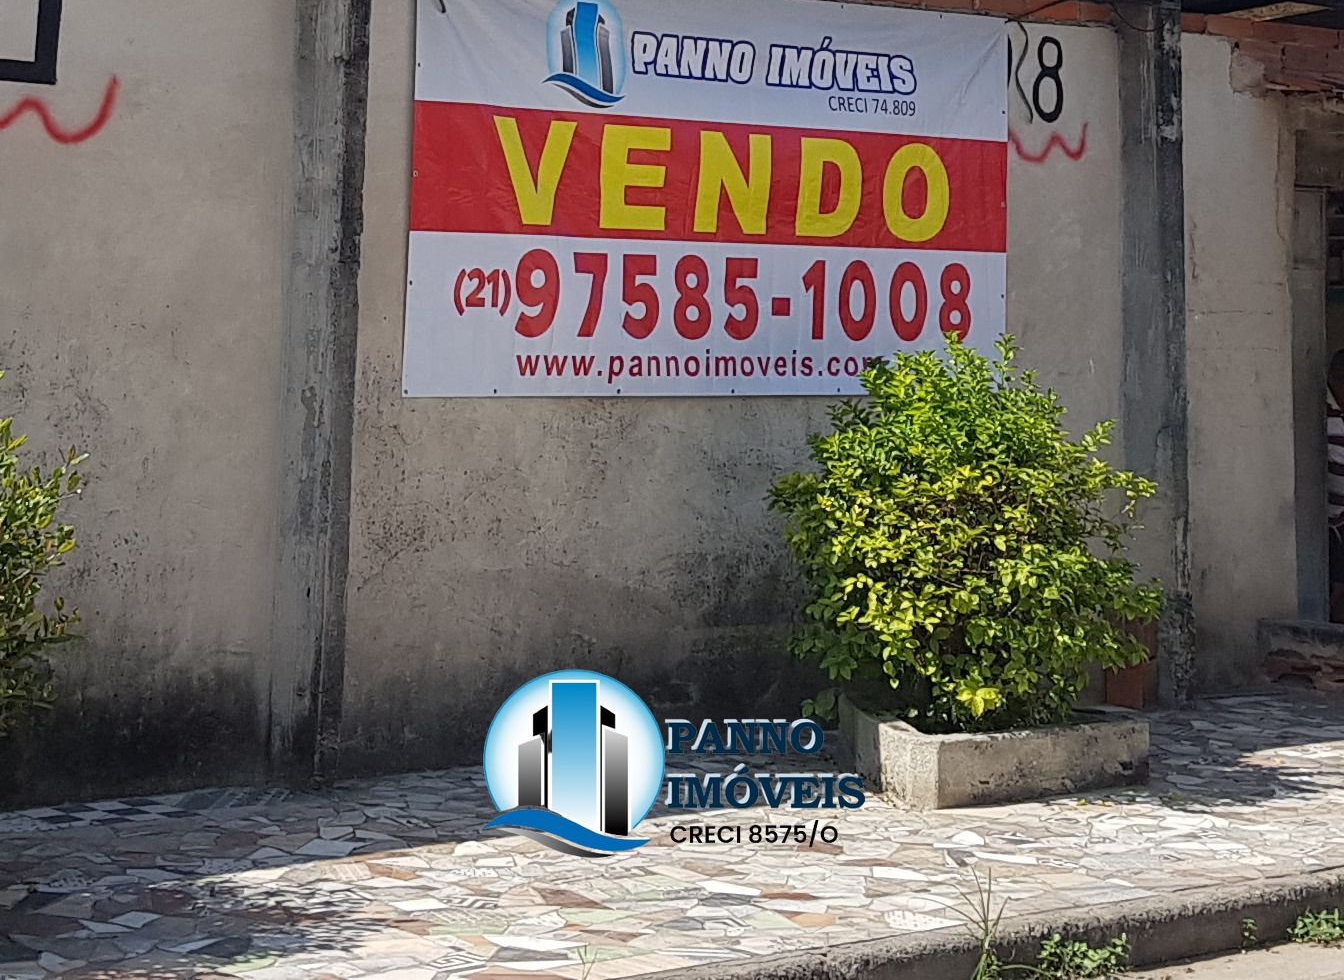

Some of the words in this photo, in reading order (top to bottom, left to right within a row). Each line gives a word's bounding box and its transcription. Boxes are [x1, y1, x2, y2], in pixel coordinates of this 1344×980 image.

[631, 31, 756, 84] PANNO
[766, 37, 917, 94] IMÓVEIS
[828, 96, 867, 114] CRECI
[873, 98, 916, 116] 74.809
[493, 114, 950, 242] VENDO
[516, 348, 876, 384] www.pannoimoveis.co
